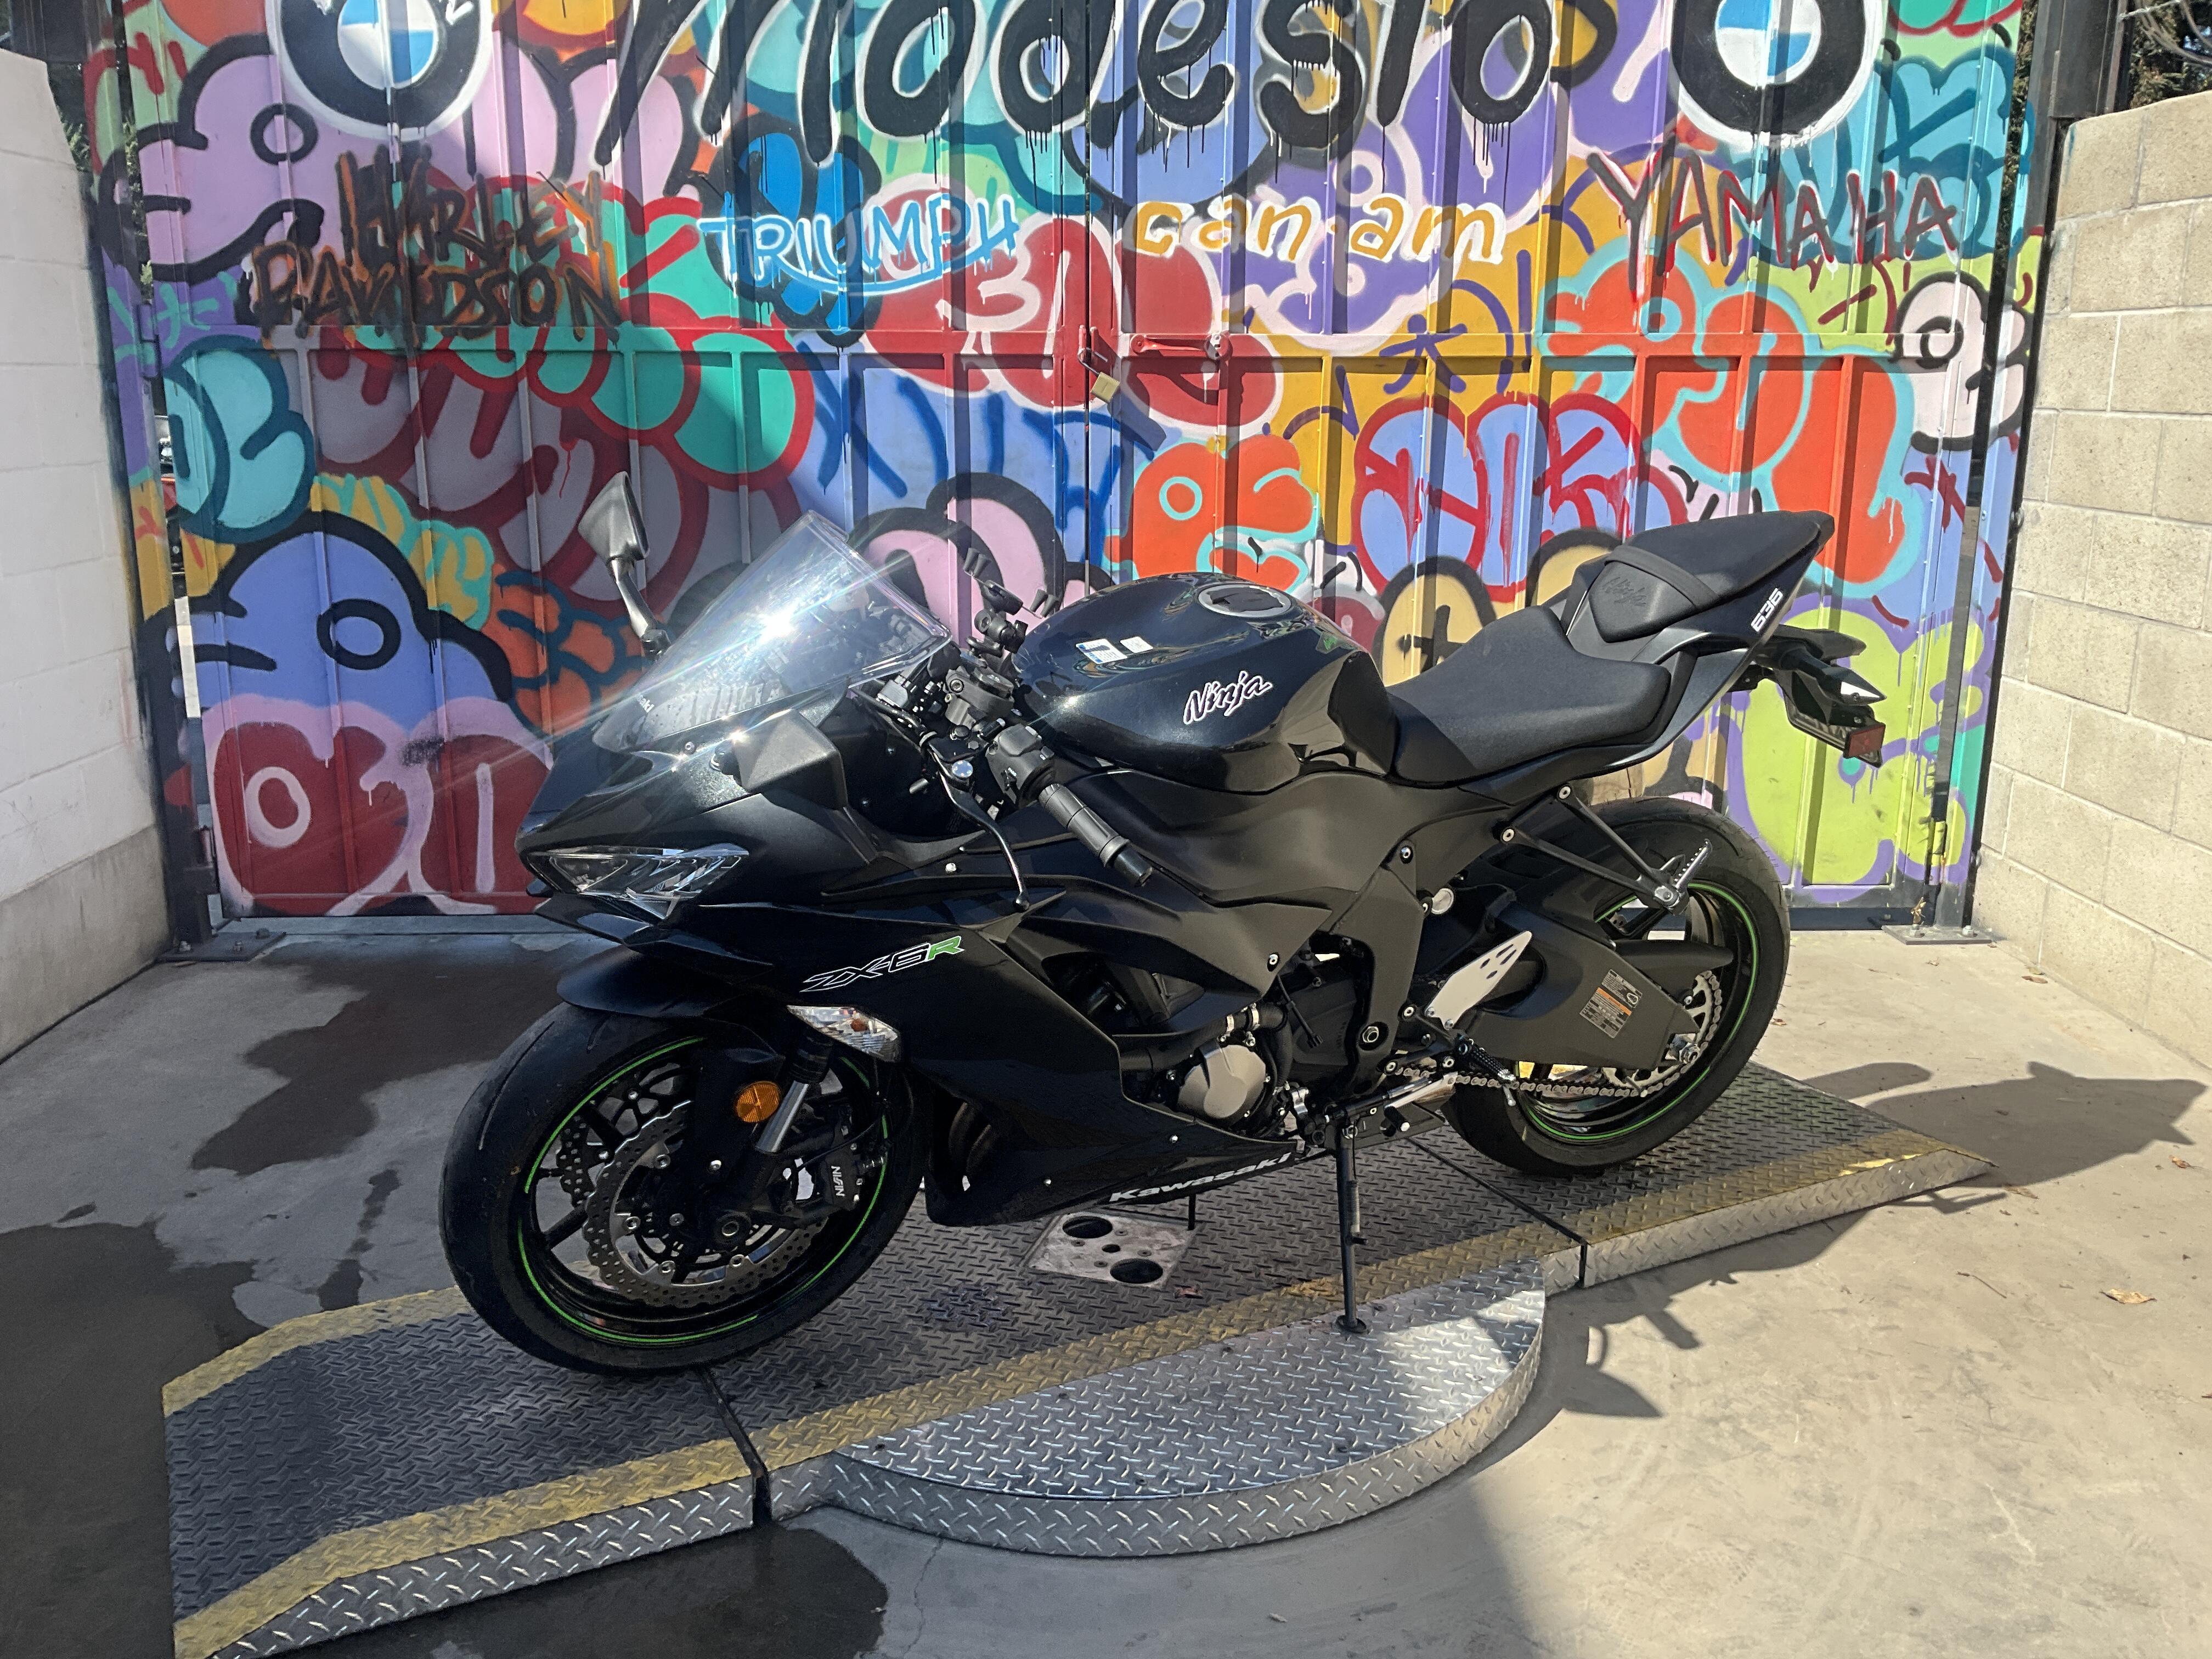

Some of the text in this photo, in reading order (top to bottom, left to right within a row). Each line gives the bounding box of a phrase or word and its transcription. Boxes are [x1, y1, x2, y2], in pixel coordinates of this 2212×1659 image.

[1586, 128, 1958, 302] YAMAHA
[696, 191, 1020, 297] TRIUMPH
[1751, 588, 1784, 632] 636
[1183, 670, 1273, 725] Ninja
[799, 935, 966, 992] ZX-6R
[1109, 1152, 1291, 1202] Kawasaki
